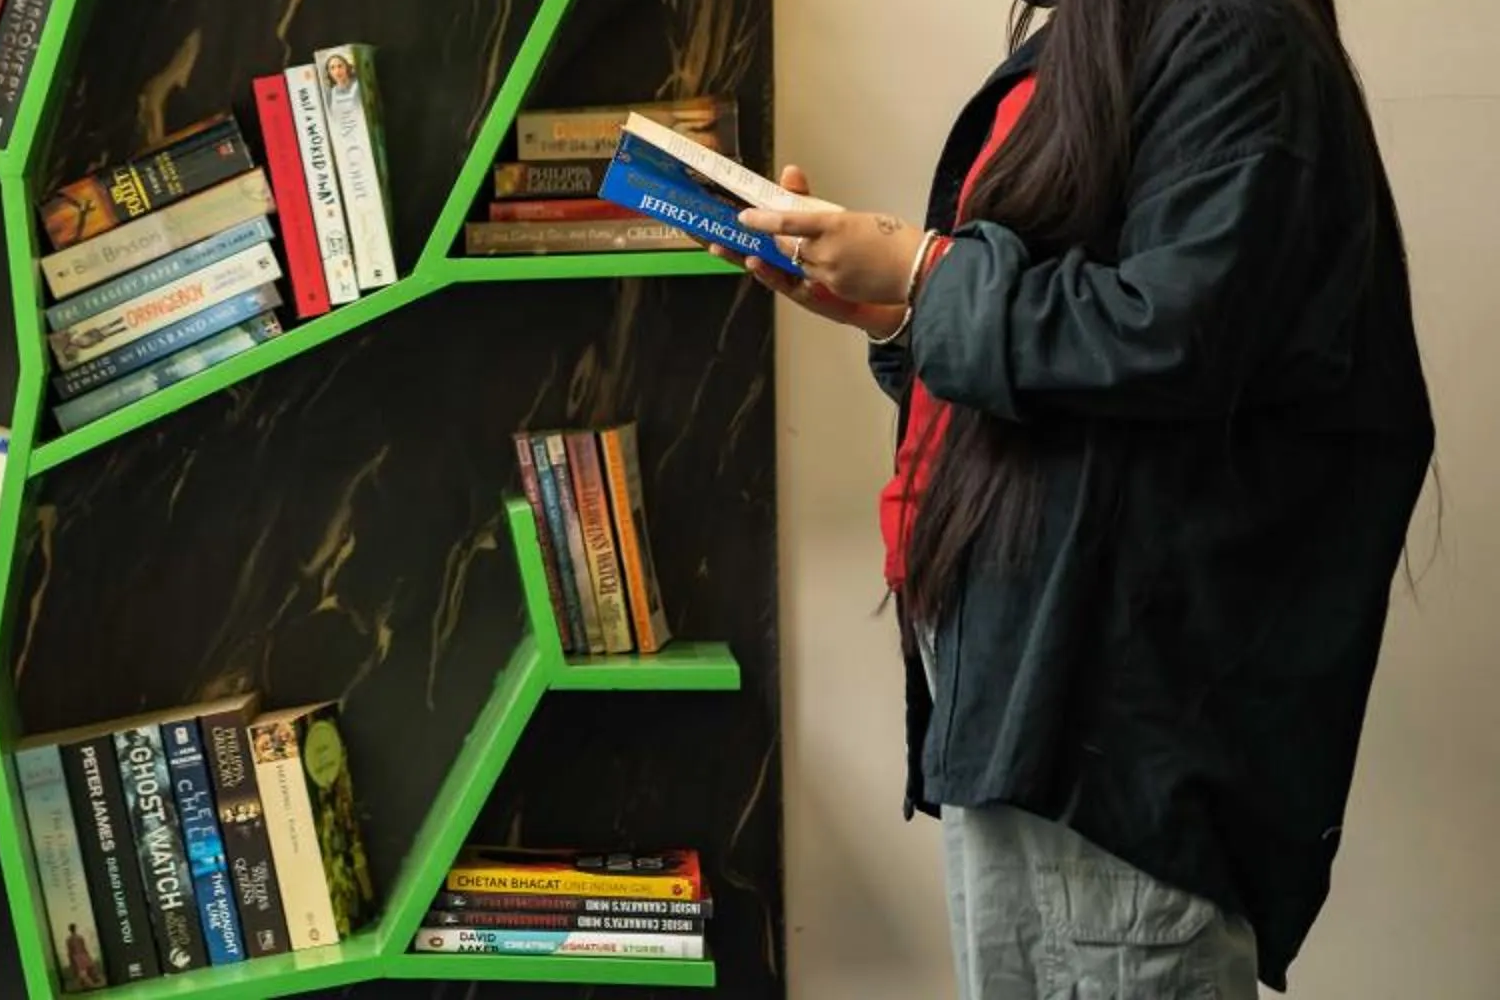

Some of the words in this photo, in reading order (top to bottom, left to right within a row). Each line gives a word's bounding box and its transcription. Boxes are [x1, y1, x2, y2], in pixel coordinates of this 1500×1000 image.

[527, 164, 593, 181] PHILIPPA
[637, 191, 703, 232] JEFFREY
[697, 214, 763, 253] ARCHER
[133, 316, 207, 358] HUSBAND
[592, 550, 620, 597] WATCH
[79, 745, 104, 798] PETER
[128, 744, 167, 824] GHOST
[90, 798, 117, 853] JAMES
[175, 777, 206, 861] CHILD
[192, 788, 216, 838] LEE
[105, 855, 122, 890] DEAD
[144, 824, 184, 912] WATCH
[456, 875, 508, 888] CHETAN
[510, 877, 561, 890] BHAGAT
[210, 871, 226, 897] THE
[112, 889, 129, 918] LIKE
[583, 898, 609, 911] MIND
[610, 899, 667, 914] CHANAKYA'S
[669, 901, 701, 915] INSIDE
[118, 917, 134, 945] YOU
[216, 897, 238, 956] MIDNIGHT
[576, 915, 601, 928] MIND
[603, 916, 659, 930] CHANAKYA'S
[661, 918, 693, 930] INSIDE
[459, 931, 497, 943] DAVID
